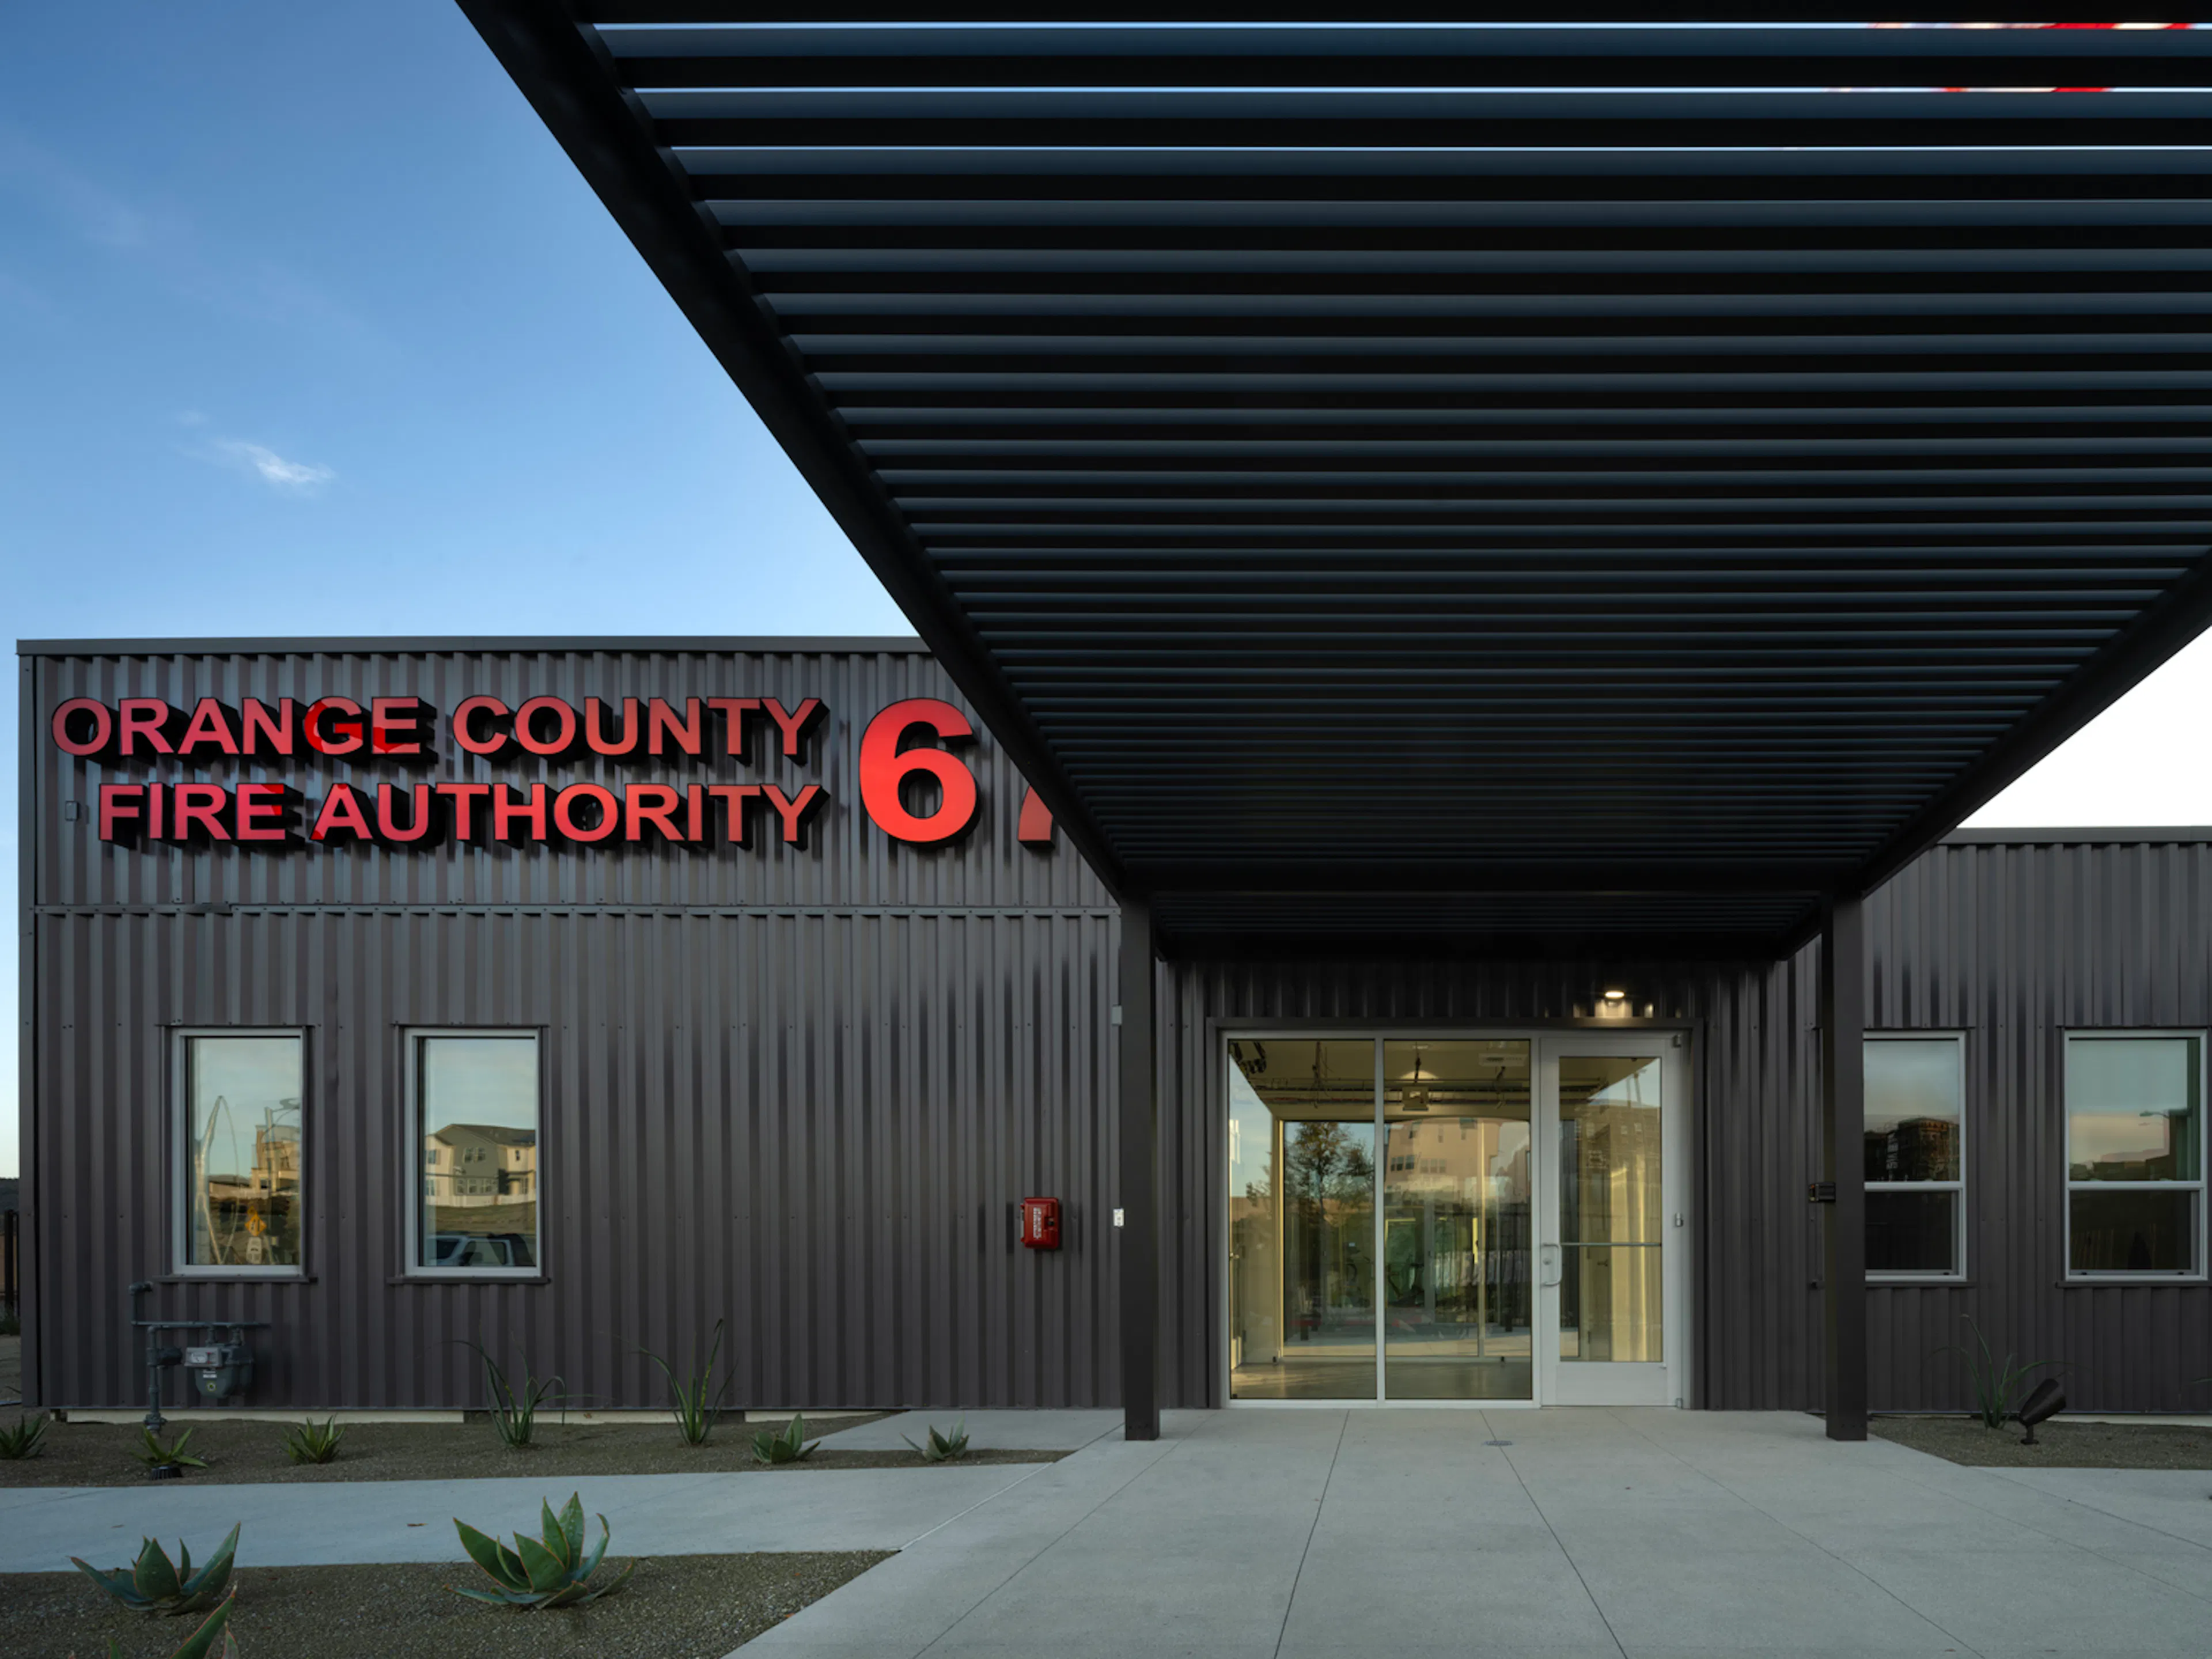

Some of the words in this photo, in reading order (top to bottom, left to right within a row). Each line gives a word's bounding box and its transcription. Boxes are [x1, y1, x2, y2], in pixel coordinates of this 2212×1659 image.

[51, 696, 421, 756] ORANGE
[453, 695, 821, 755] COUNTY
[859, 698, 1053, 842] 6
[99, 783, 286, 841] FIRE
[310, 782, 821, 842] AUTHORITY
